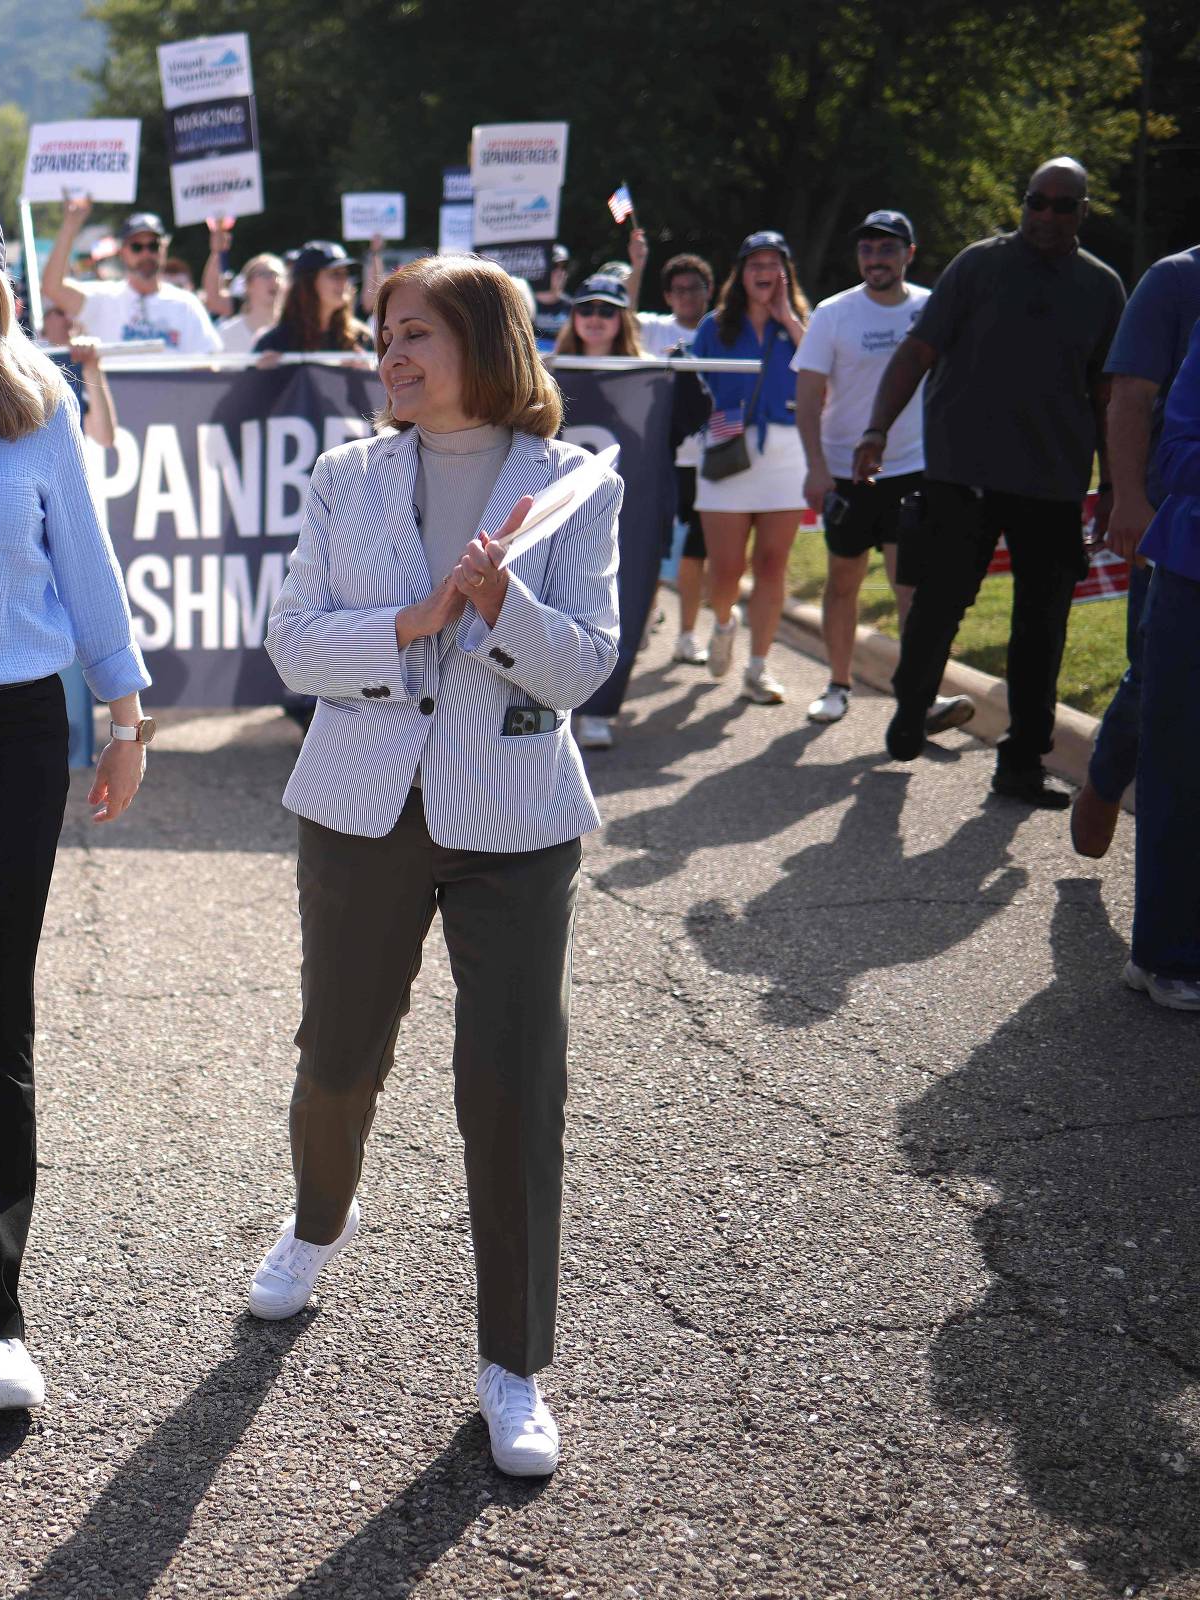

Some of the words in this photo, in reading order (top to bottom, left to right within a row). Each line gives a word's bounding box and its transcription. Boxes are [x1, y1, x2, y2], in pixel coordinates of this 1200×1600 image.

[174, 105, 246, 133] MAKING
[30, 151, 130, 174] SPANBERGER
[480, 149, 559, 167] SPANBERGER
[126, 552, 286, 652] SHM
